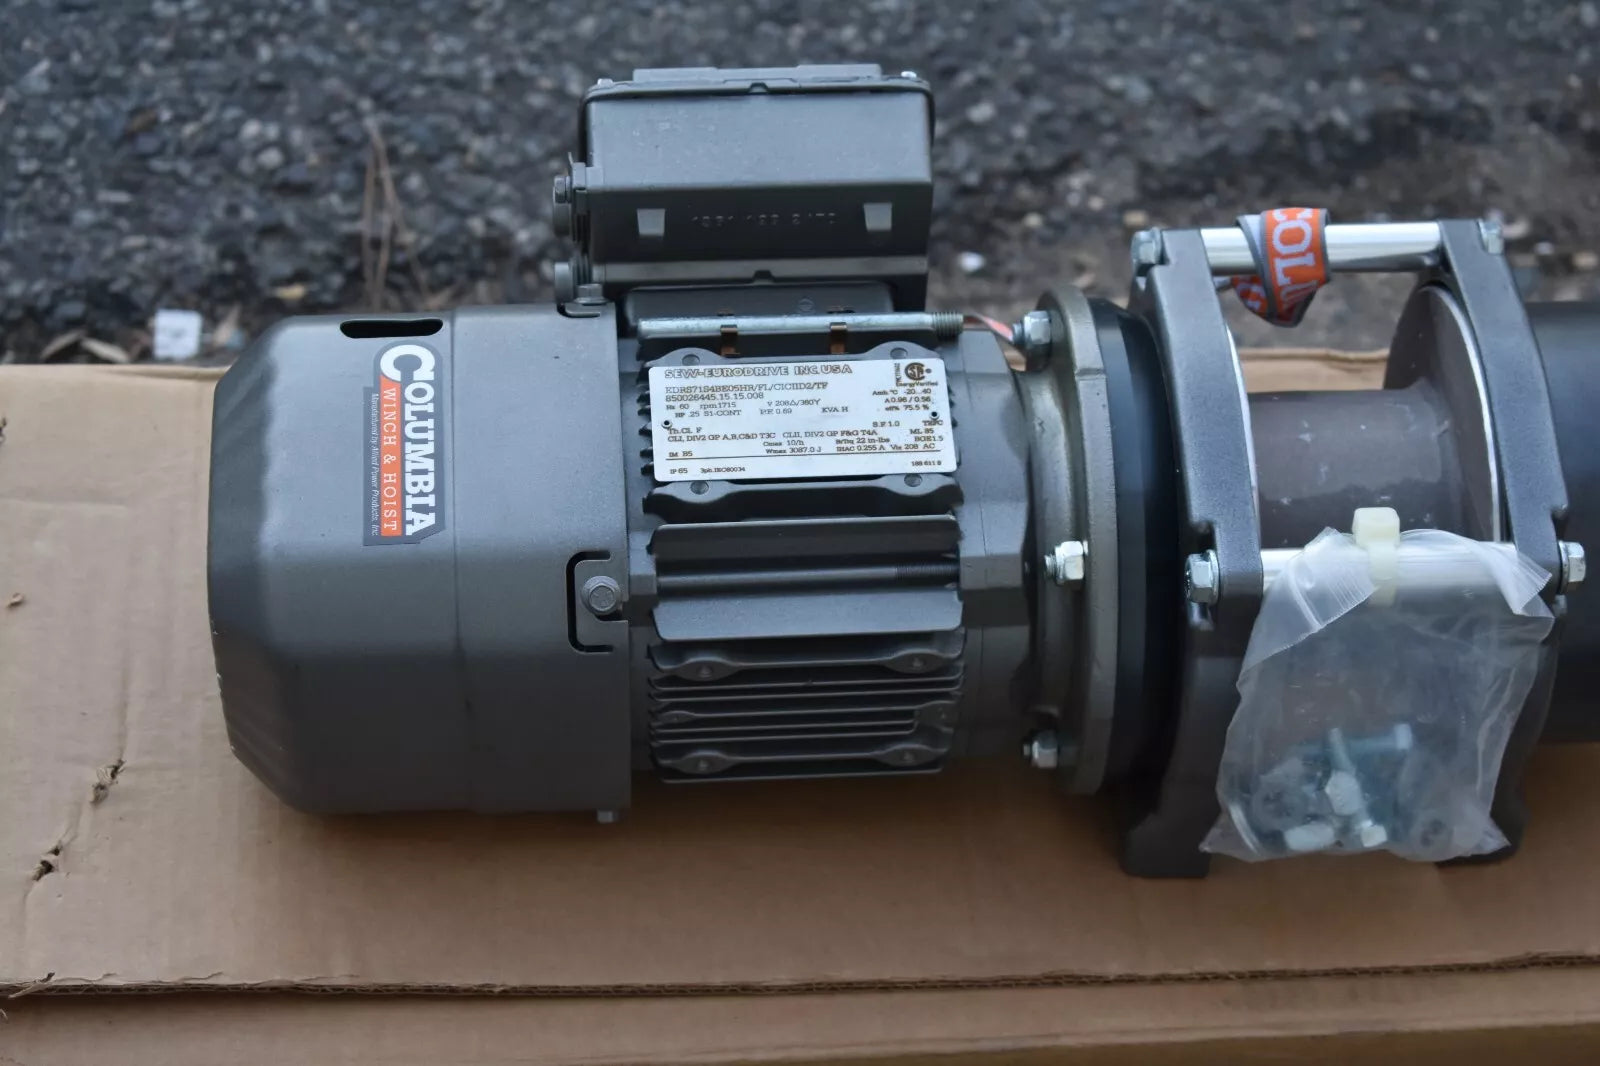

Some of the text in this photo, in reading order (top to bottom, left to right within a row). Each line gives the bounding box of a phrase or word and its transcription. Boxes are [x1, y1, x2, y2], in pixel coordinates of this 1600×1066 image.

[665, 366, 789, 378] SEW-EURODRIVE
[371, 392, 380, 435] Manufactured
[380, 344, 436, 536] COLUMBIA
[686, 434, 707, 442] DIV2
[708, 433, 721, 441] GP
[804, 430, 824, 438] DIV2
[371, 446, 379, 466] Allied
[383, 387, 397, 530] WINCH & HOIST
[371, 467, 379, 488] Power
